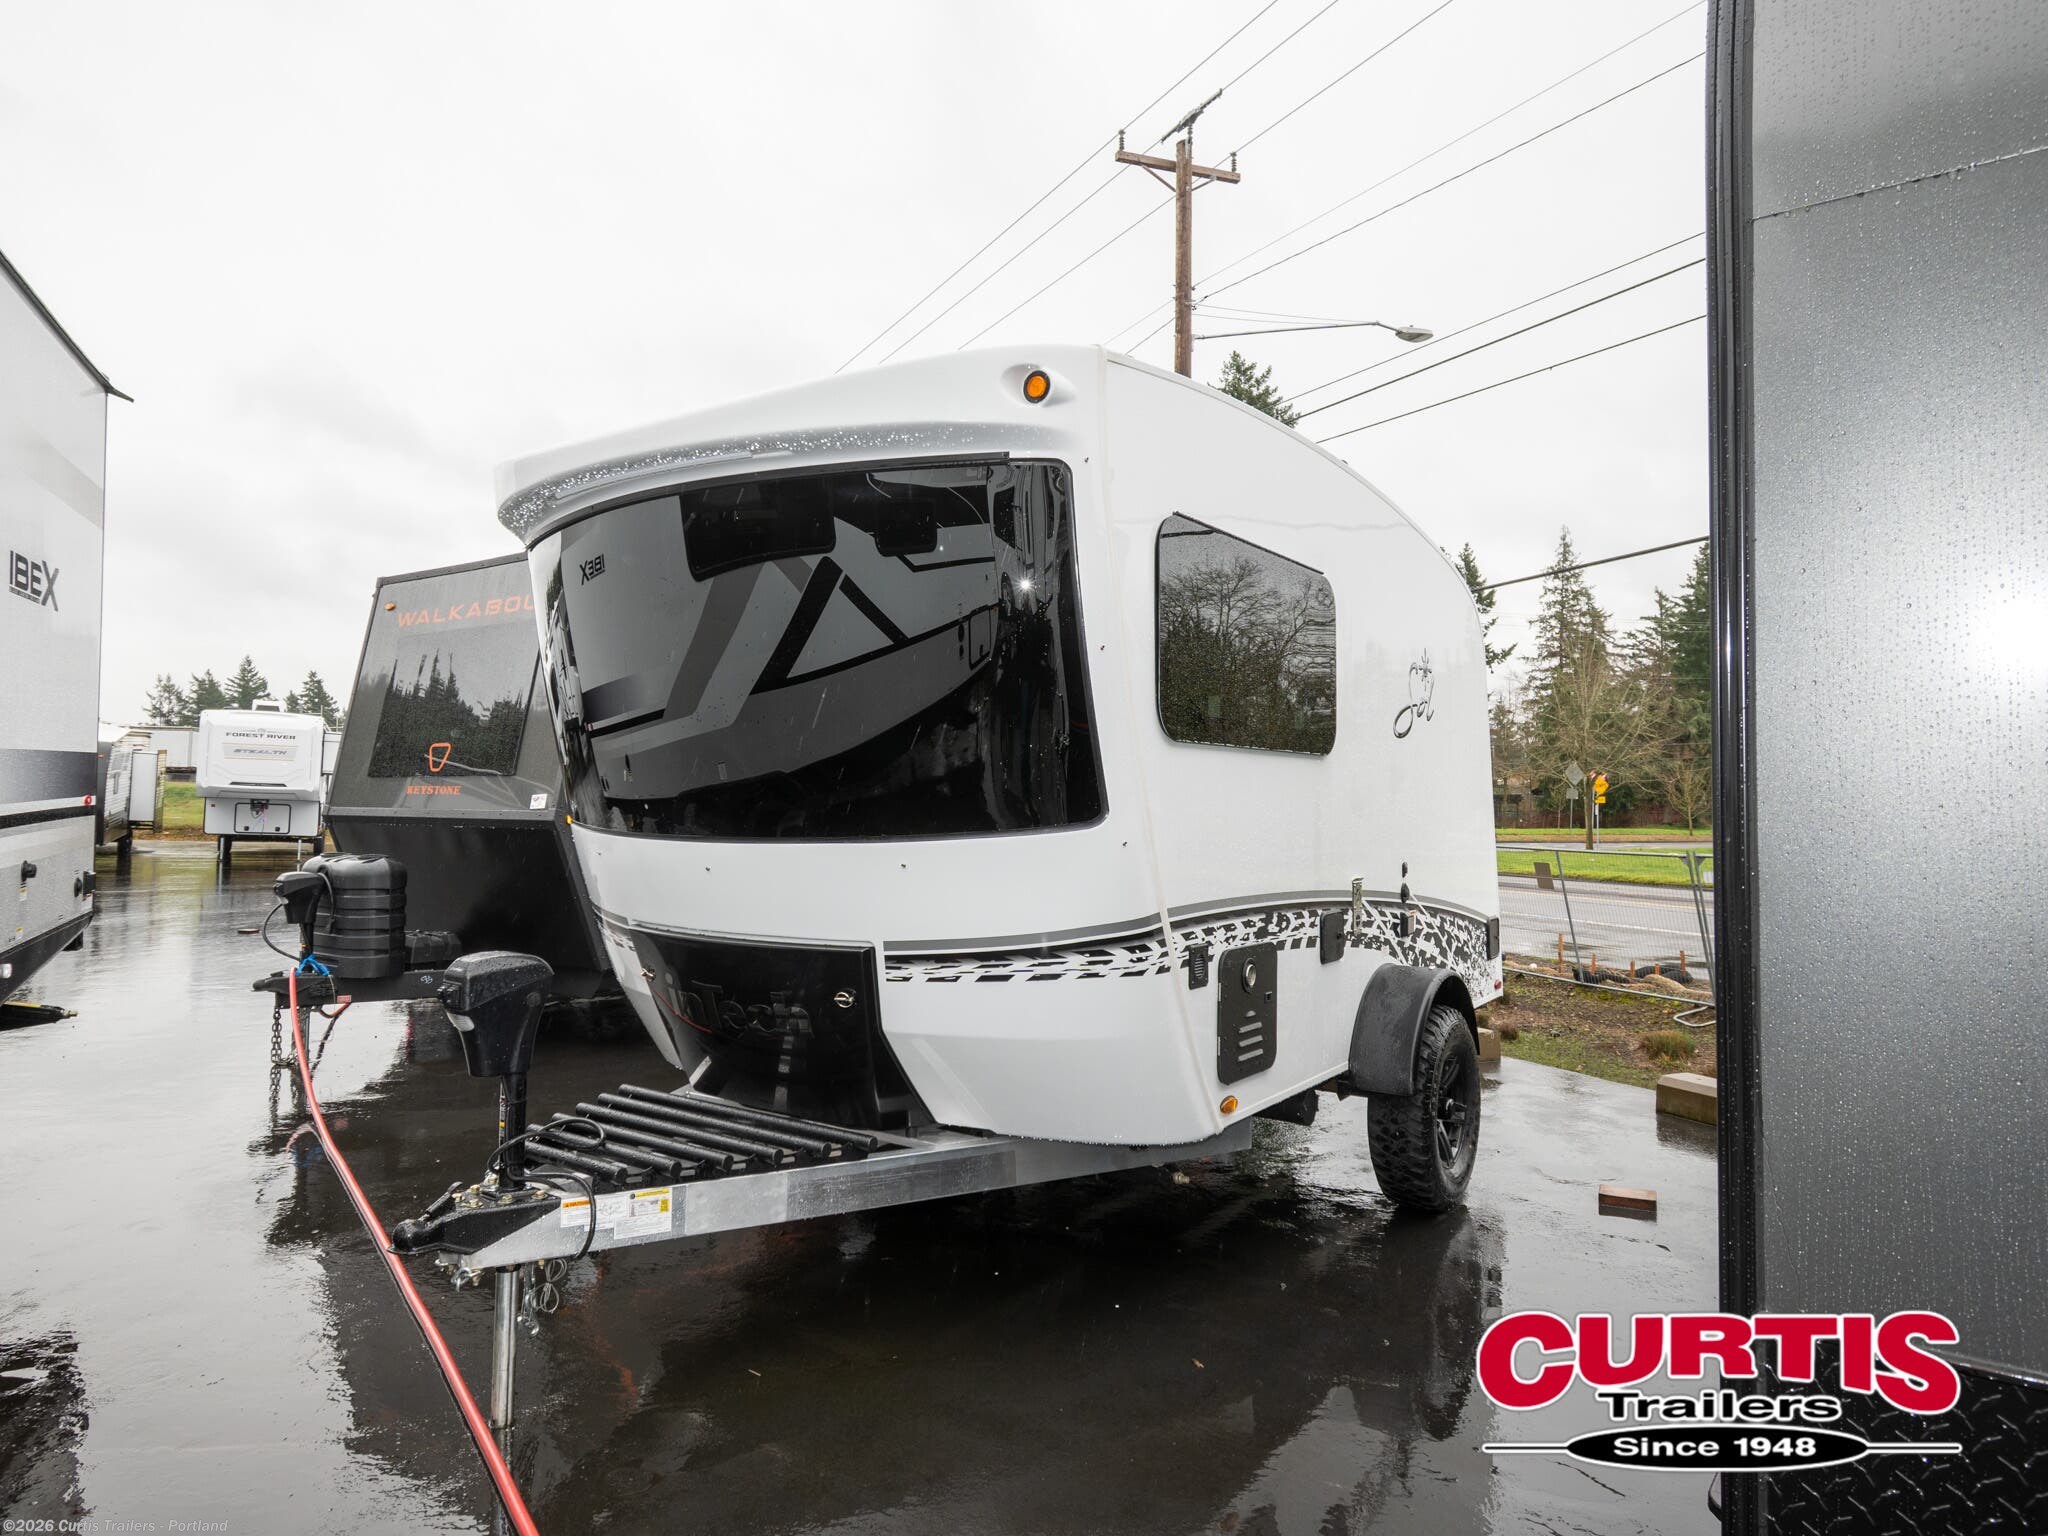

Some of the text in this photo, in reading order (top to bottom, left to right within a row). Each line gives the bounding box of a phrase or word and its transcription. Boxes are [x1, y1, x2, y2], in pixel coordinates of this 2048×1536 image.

[10, 550, 60, 612] IBEX
[399, 594, 535, 628] WALKABOU
[225, 731, 265, 739] FOREST
[406, 785, 463, 795] KEYSTONE
